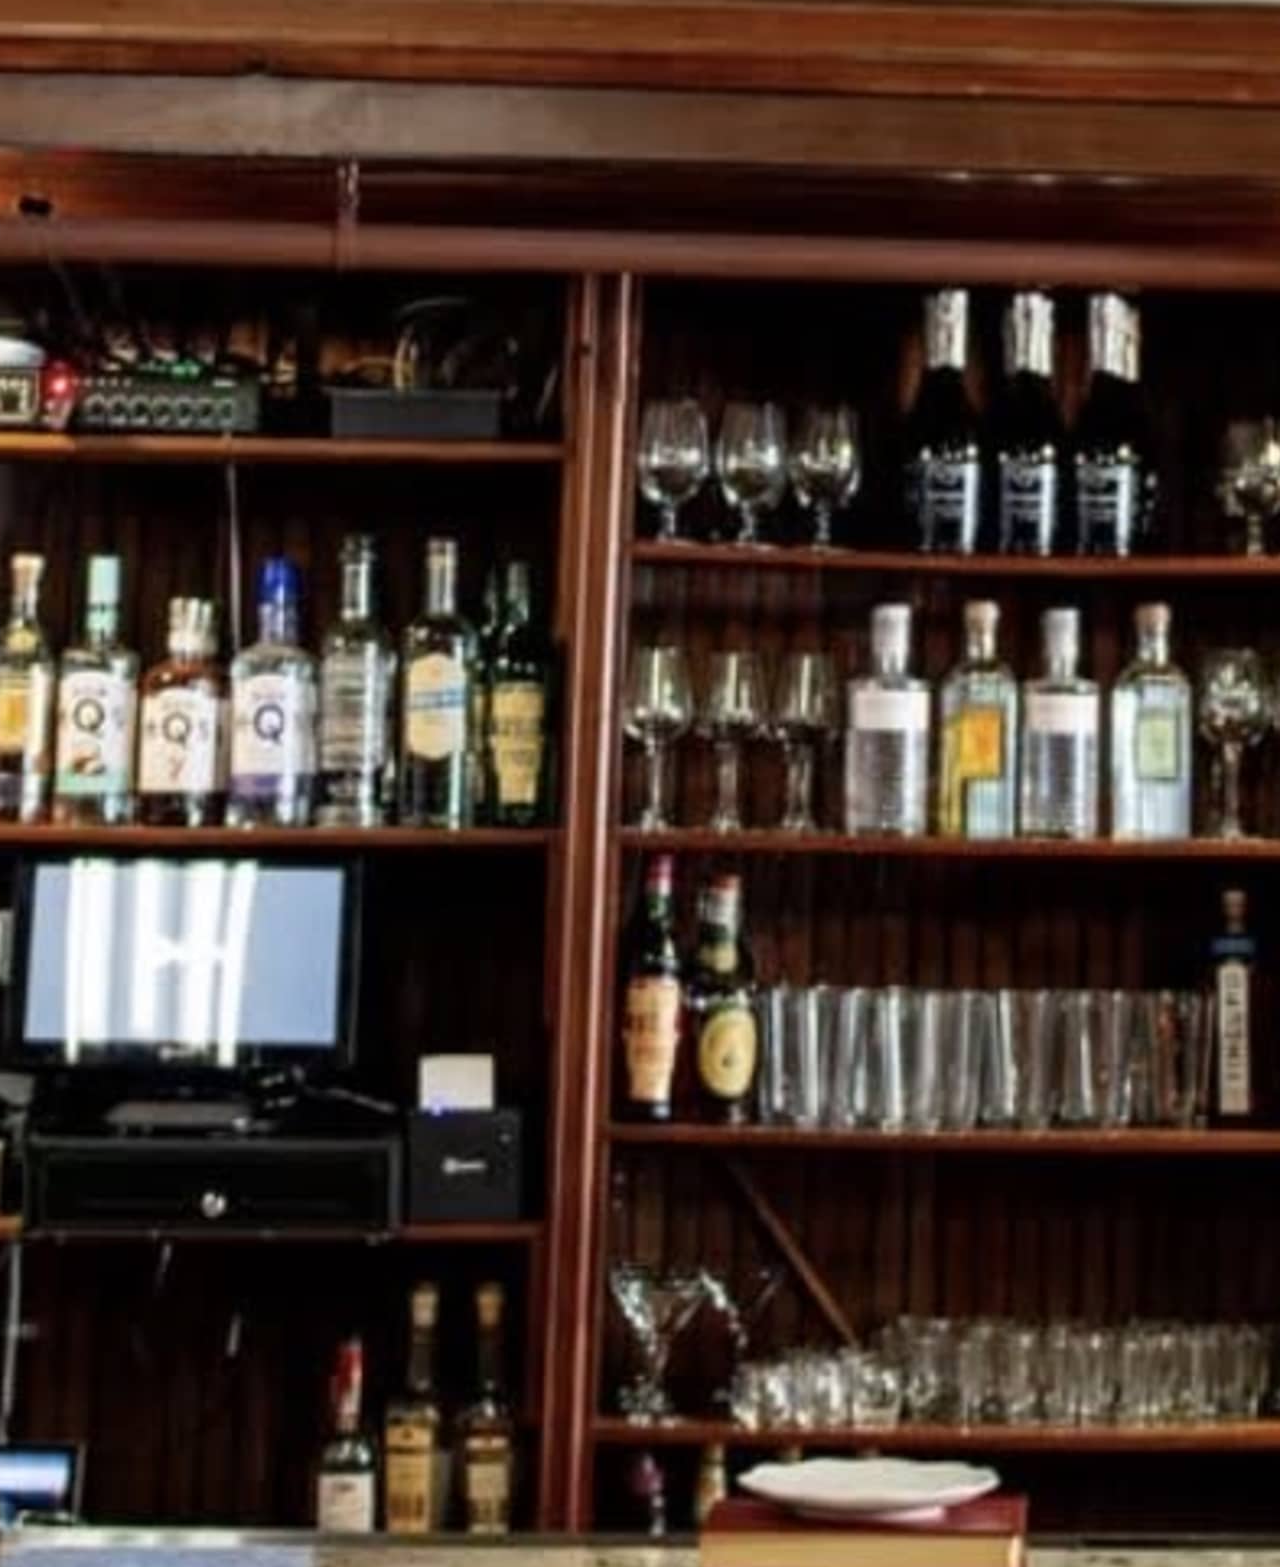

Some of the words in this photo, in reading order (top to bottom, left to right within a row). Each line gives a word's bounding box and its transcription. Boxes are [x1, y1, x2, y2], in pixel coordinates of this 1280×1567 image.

[73, 698, 105, 736] Q
[161, 712, 191, 748] Q
[254, 704, 284, 743] Q
